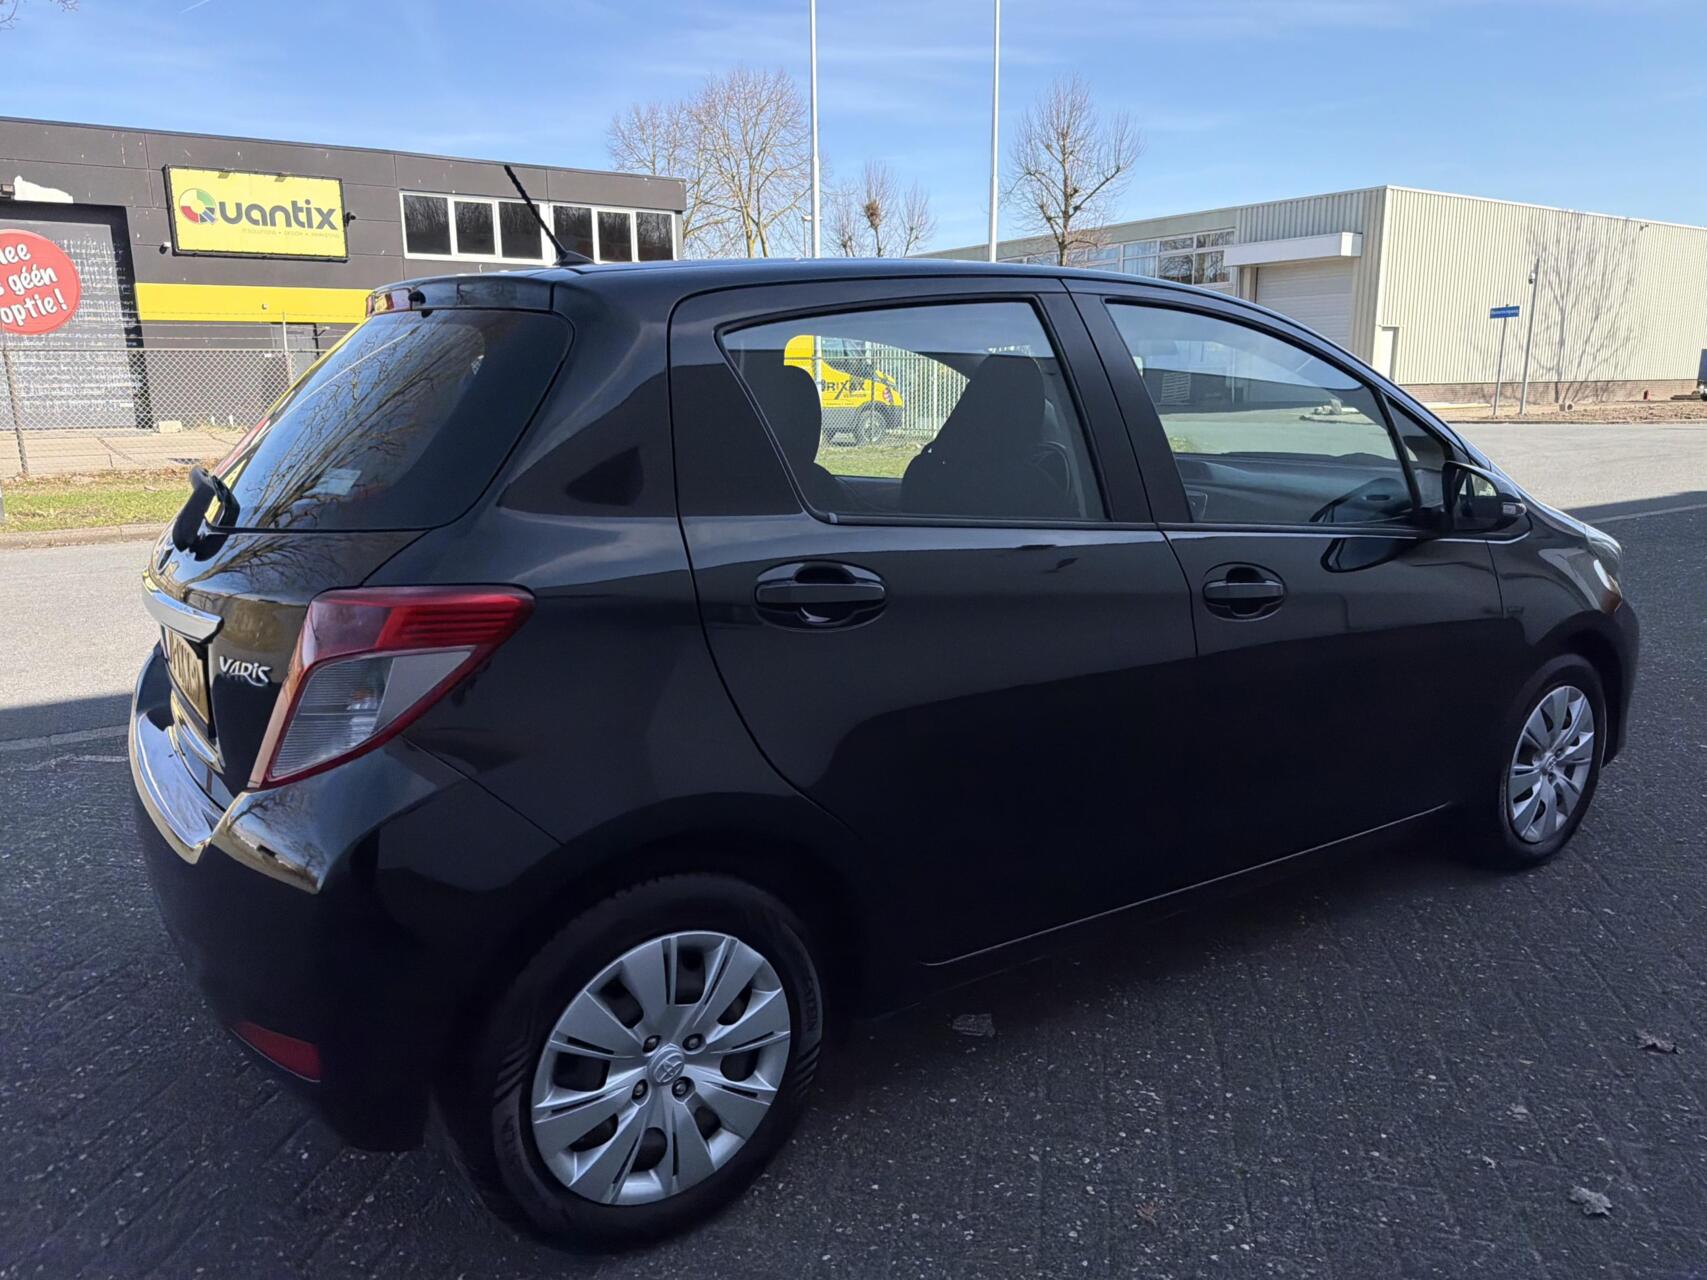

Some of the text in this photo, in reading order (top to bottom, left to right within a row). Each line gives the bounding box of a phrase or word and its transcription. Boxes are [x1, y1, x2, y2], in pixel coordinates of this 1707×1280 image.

[179, 187, 338, 231] Quantix
[8, 264, 58, 295] géén
[0, 288, 68, 326] optie!
